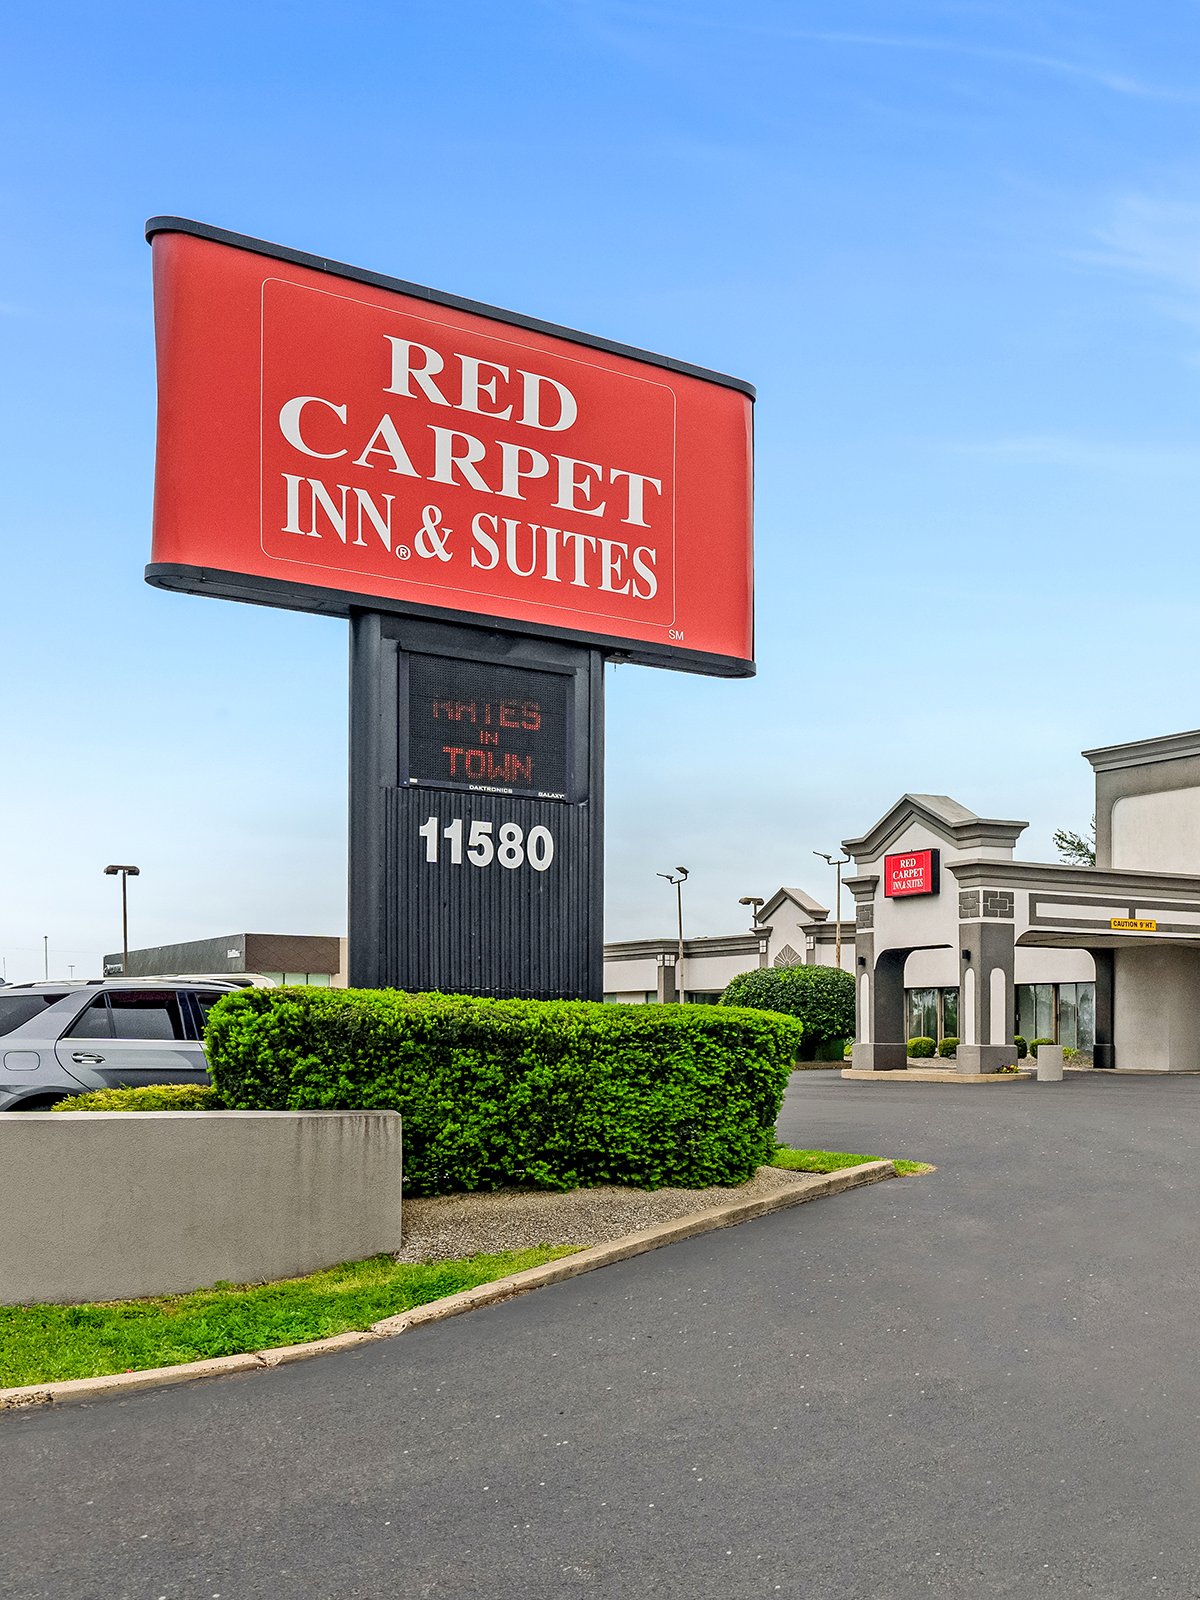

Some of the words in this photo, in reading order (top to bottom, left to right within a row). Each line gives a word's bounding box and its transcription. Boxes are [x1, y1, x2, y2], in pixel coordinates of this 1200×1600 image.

[382, 334, 578, 432] RED
[279, 396, 662, 528] CARPET
[414, 504, 454, 562] &
[471, 512, 658, 600] SUITES
[668, 629, 684, 641] SM
[480, 731, 498, 746] IN
[442, 745, 533, 784] TOWN
[469, 784, 513, 794] DAKTRONICS
[419, 816, 554, 872] 11580
[900, 858, 916, 868] RED
[892, 868, 924, 880] CARPET
[1113, 920, 1138, 928] CAUTION
